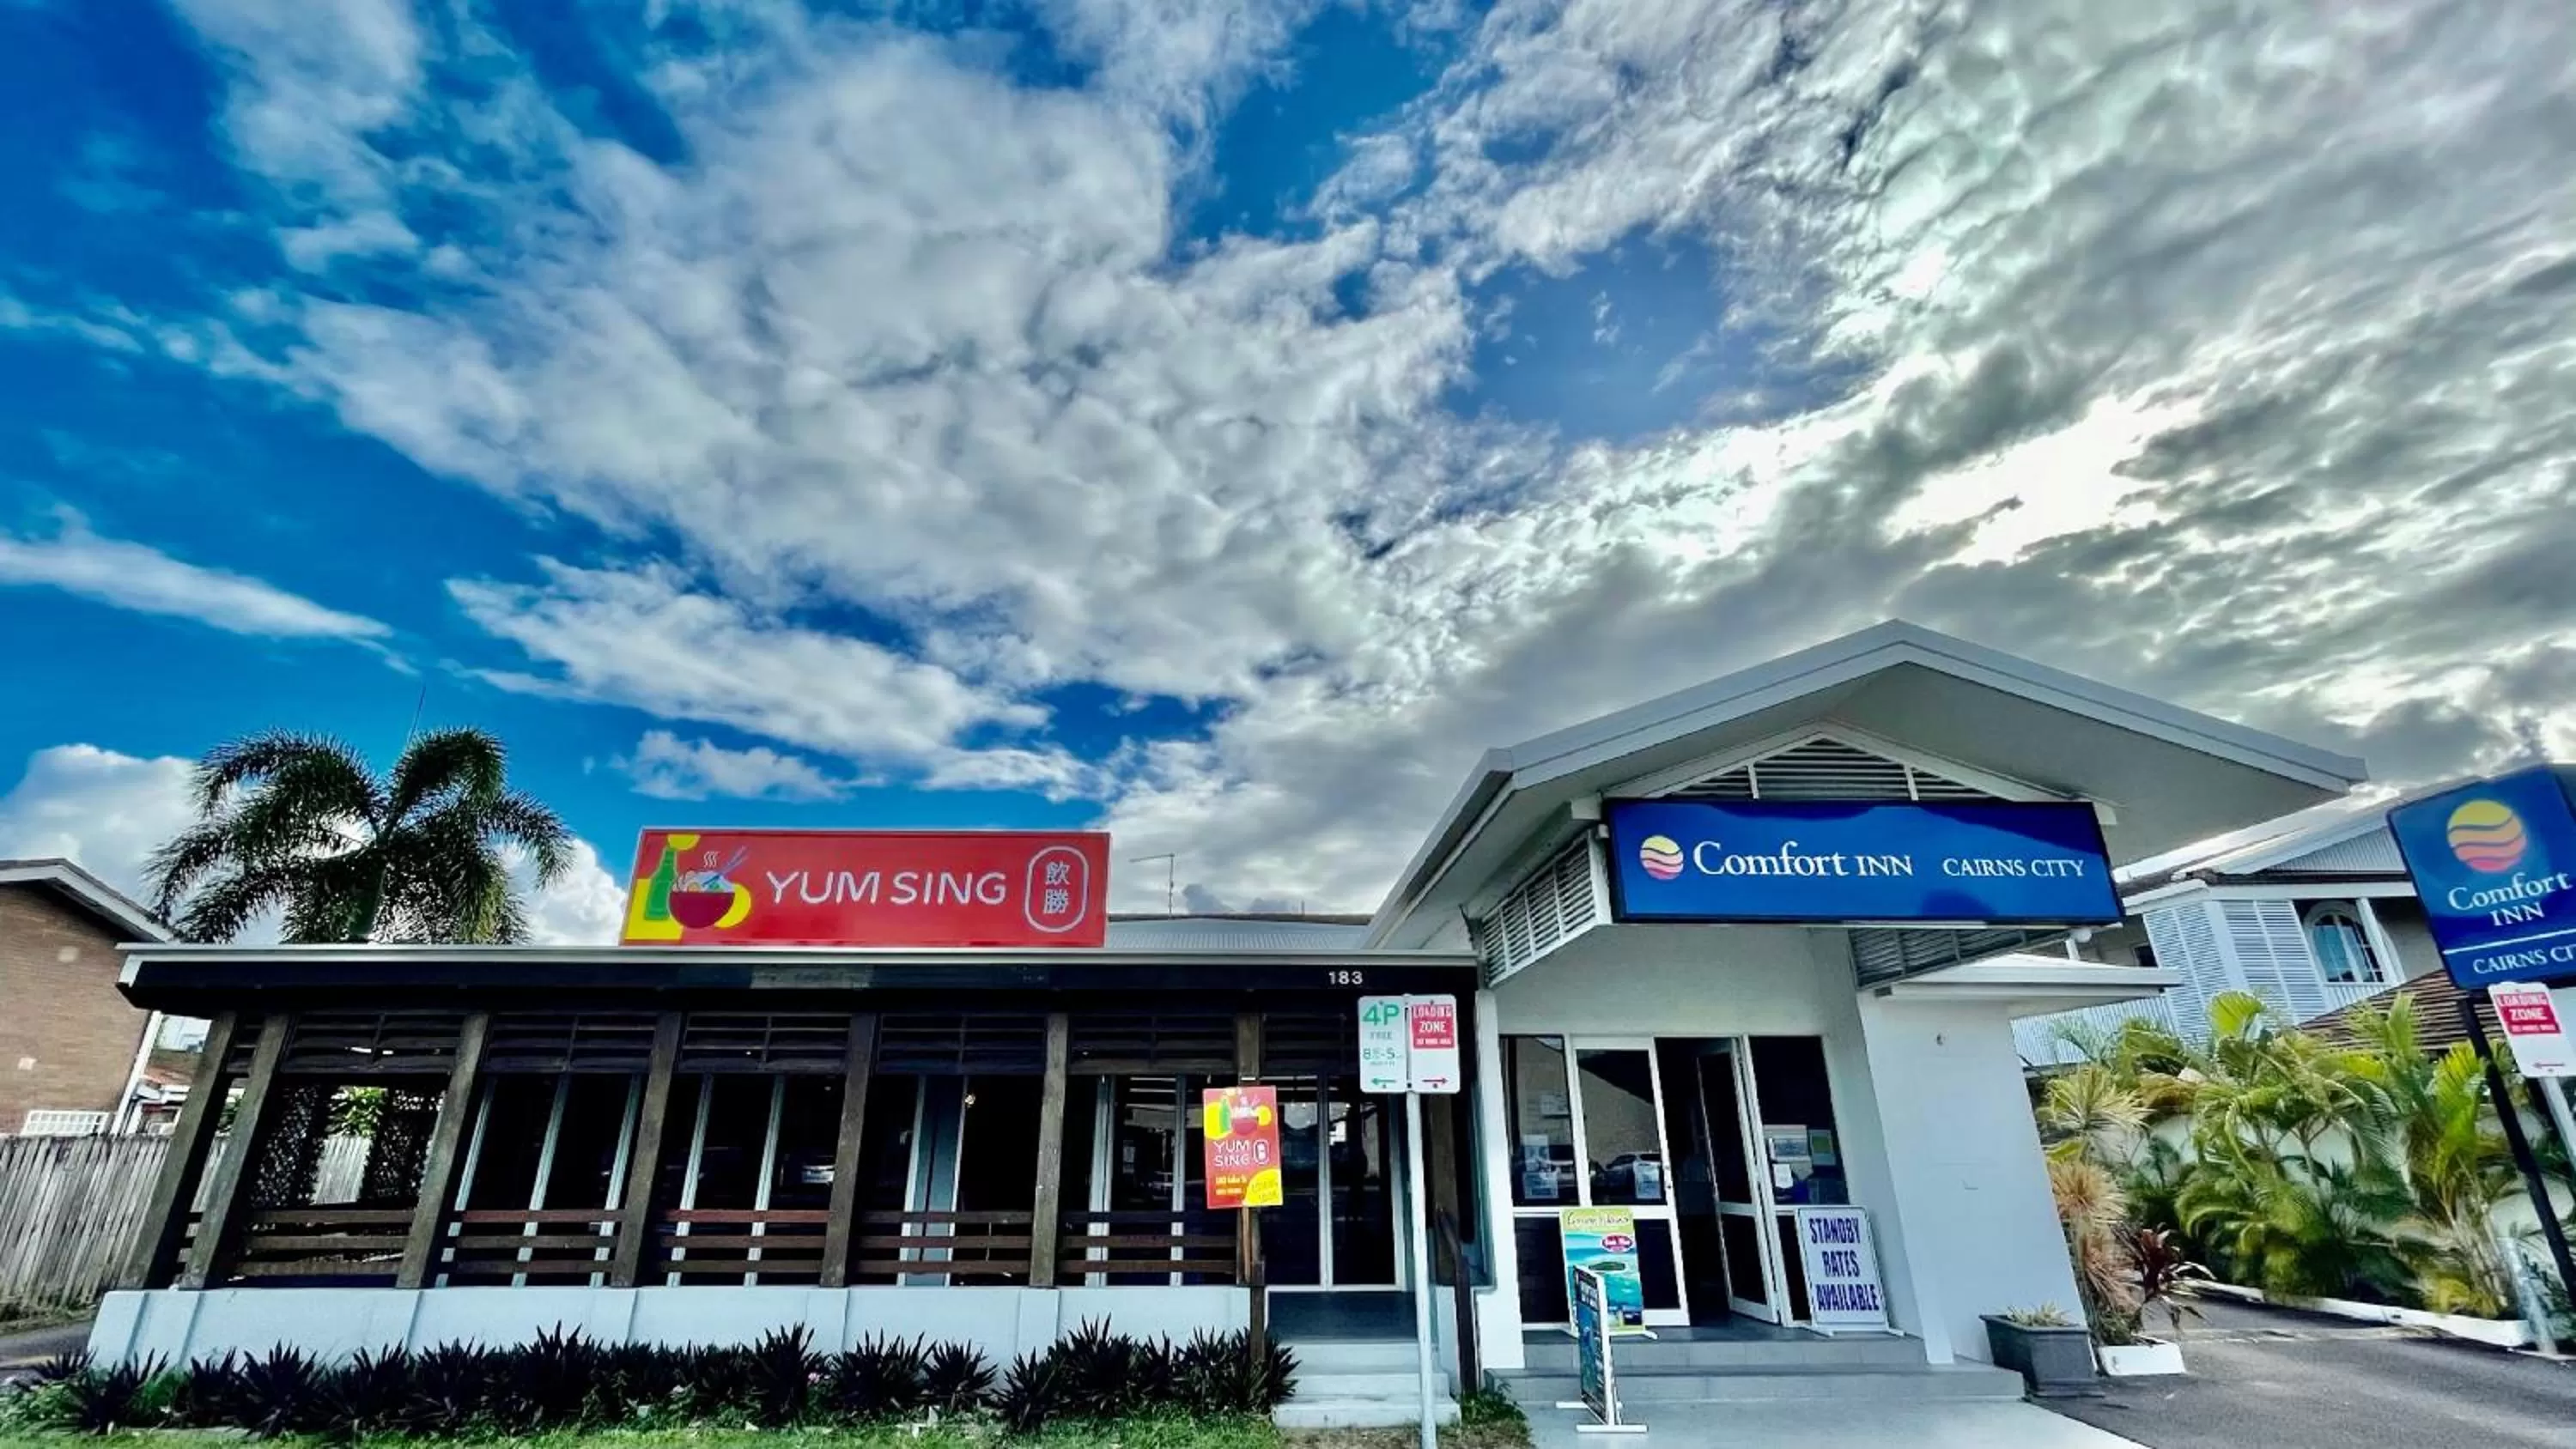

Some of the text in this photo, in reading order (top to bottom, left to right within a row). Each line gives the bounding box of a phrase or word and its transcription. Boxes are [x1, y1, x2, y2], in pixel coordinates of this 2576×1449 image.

[1693, 841, 1914, 877] Comfort INN
[1942, 858, 2085, 877] CAIRNS CITY
[766, 871, 1006, 906] YUM SING
[2447, 871, 2573, 912] Comfort
[2489, 901, 2545, 927] INN
[2473, 949, 2548, 974] CAIRNS
[1328, 971, 1364, 985] 183
[1362, 1003, 1400, 1026] 4P
[2508, 1007, 2548, 1022] ZONE
[1419, 1021, 1447, 1034] ZONE
[1212, 1139, 1250, 1155] YUM
[1214, 1153, 1250, 1167] SING
[1808, 1217, 1861, 1244] STANDBY
[1821, 1251, 1861, 1277] RATES
[1815, 1284, 1879, 1311] AVAILABLE
